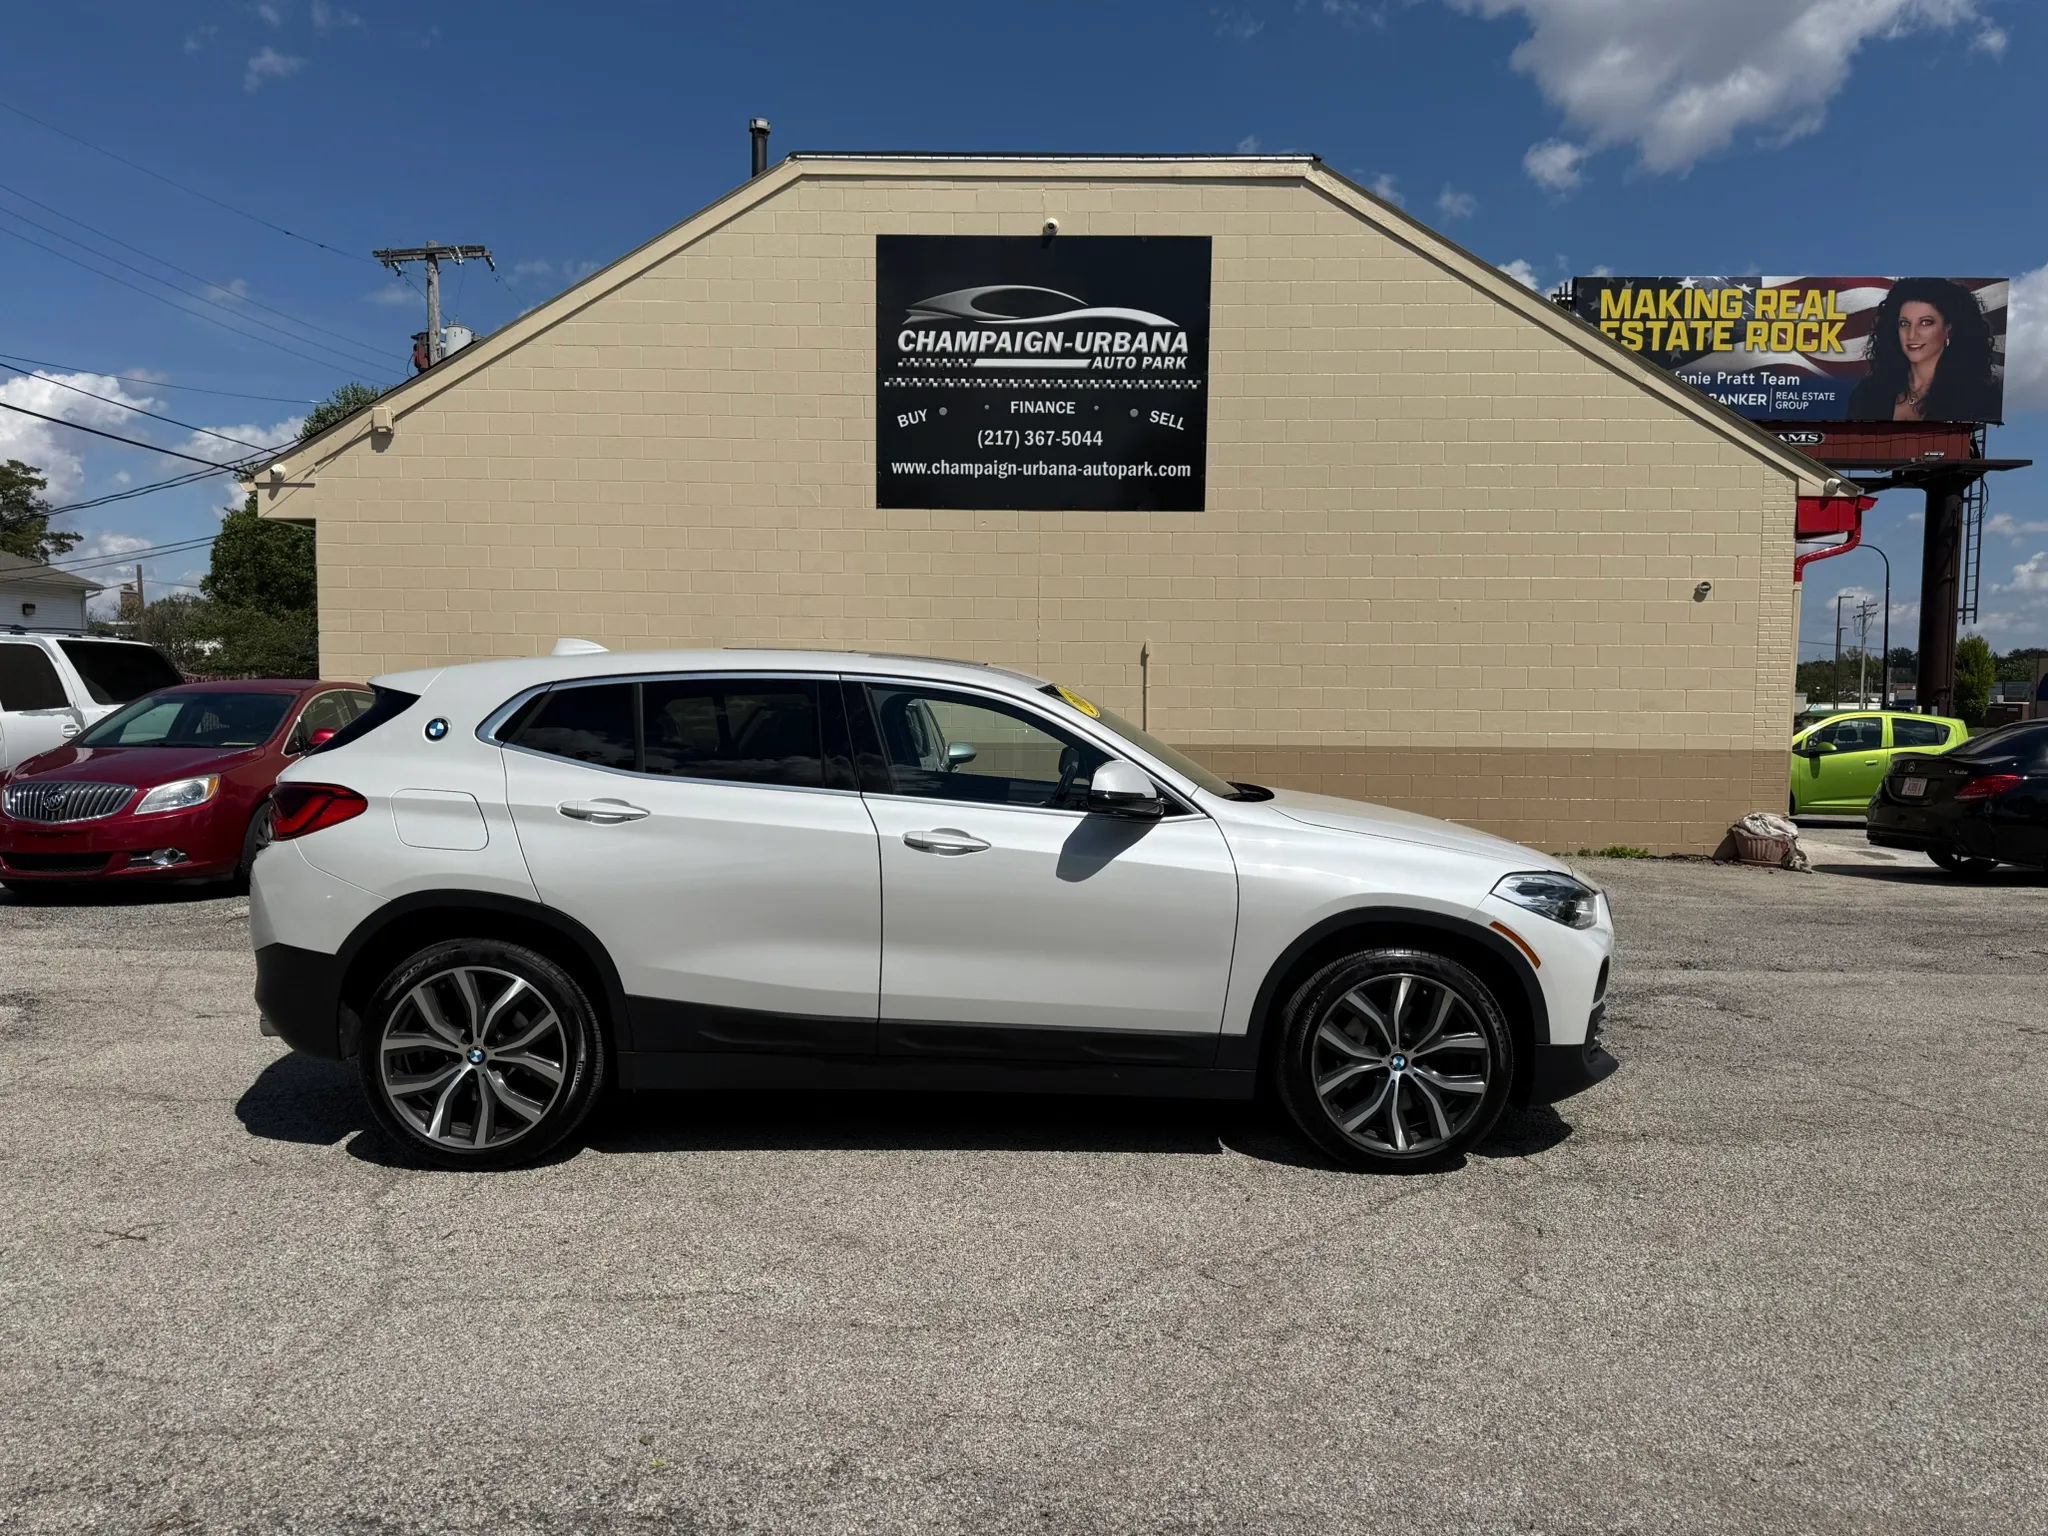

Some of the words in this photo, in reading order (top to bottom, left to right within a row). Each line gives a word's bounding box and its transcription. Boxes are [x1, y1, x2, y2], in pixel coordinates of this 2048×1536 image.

[1600, 288, 1744, 320] MAKING
[1755, 289, 1847, 320] REAL
[897, 330, 1189, 354] CHAMPAIGN-URBANA
[1600, 320, 1735, 352] ESTATE
[1745, 321, 1846, 352] ROCK
[1092, 356, 1137, 370] AUTO
[1142, 357, 1188, 370] PARK
[1717, 372, 1755, 385] Pratt
[1760, 372, 1801, 386] Team
[1775, 391, 1800, 400] REAL
[1802, 392, 1836, 401] ESTATE
[1775, 401, 1809, 410] GROUP
[1010, 401, 1076, 415] FINANCE
[897, 409, 928, 428] BUY
[1149, 410, 1185, 430] SELL
[977, 430, 1020, 449] (217)
[1024, 430, 1103, 447] 367-5044
[891, 460, 1191, 479] www.champaign-urbana-autopark.com
